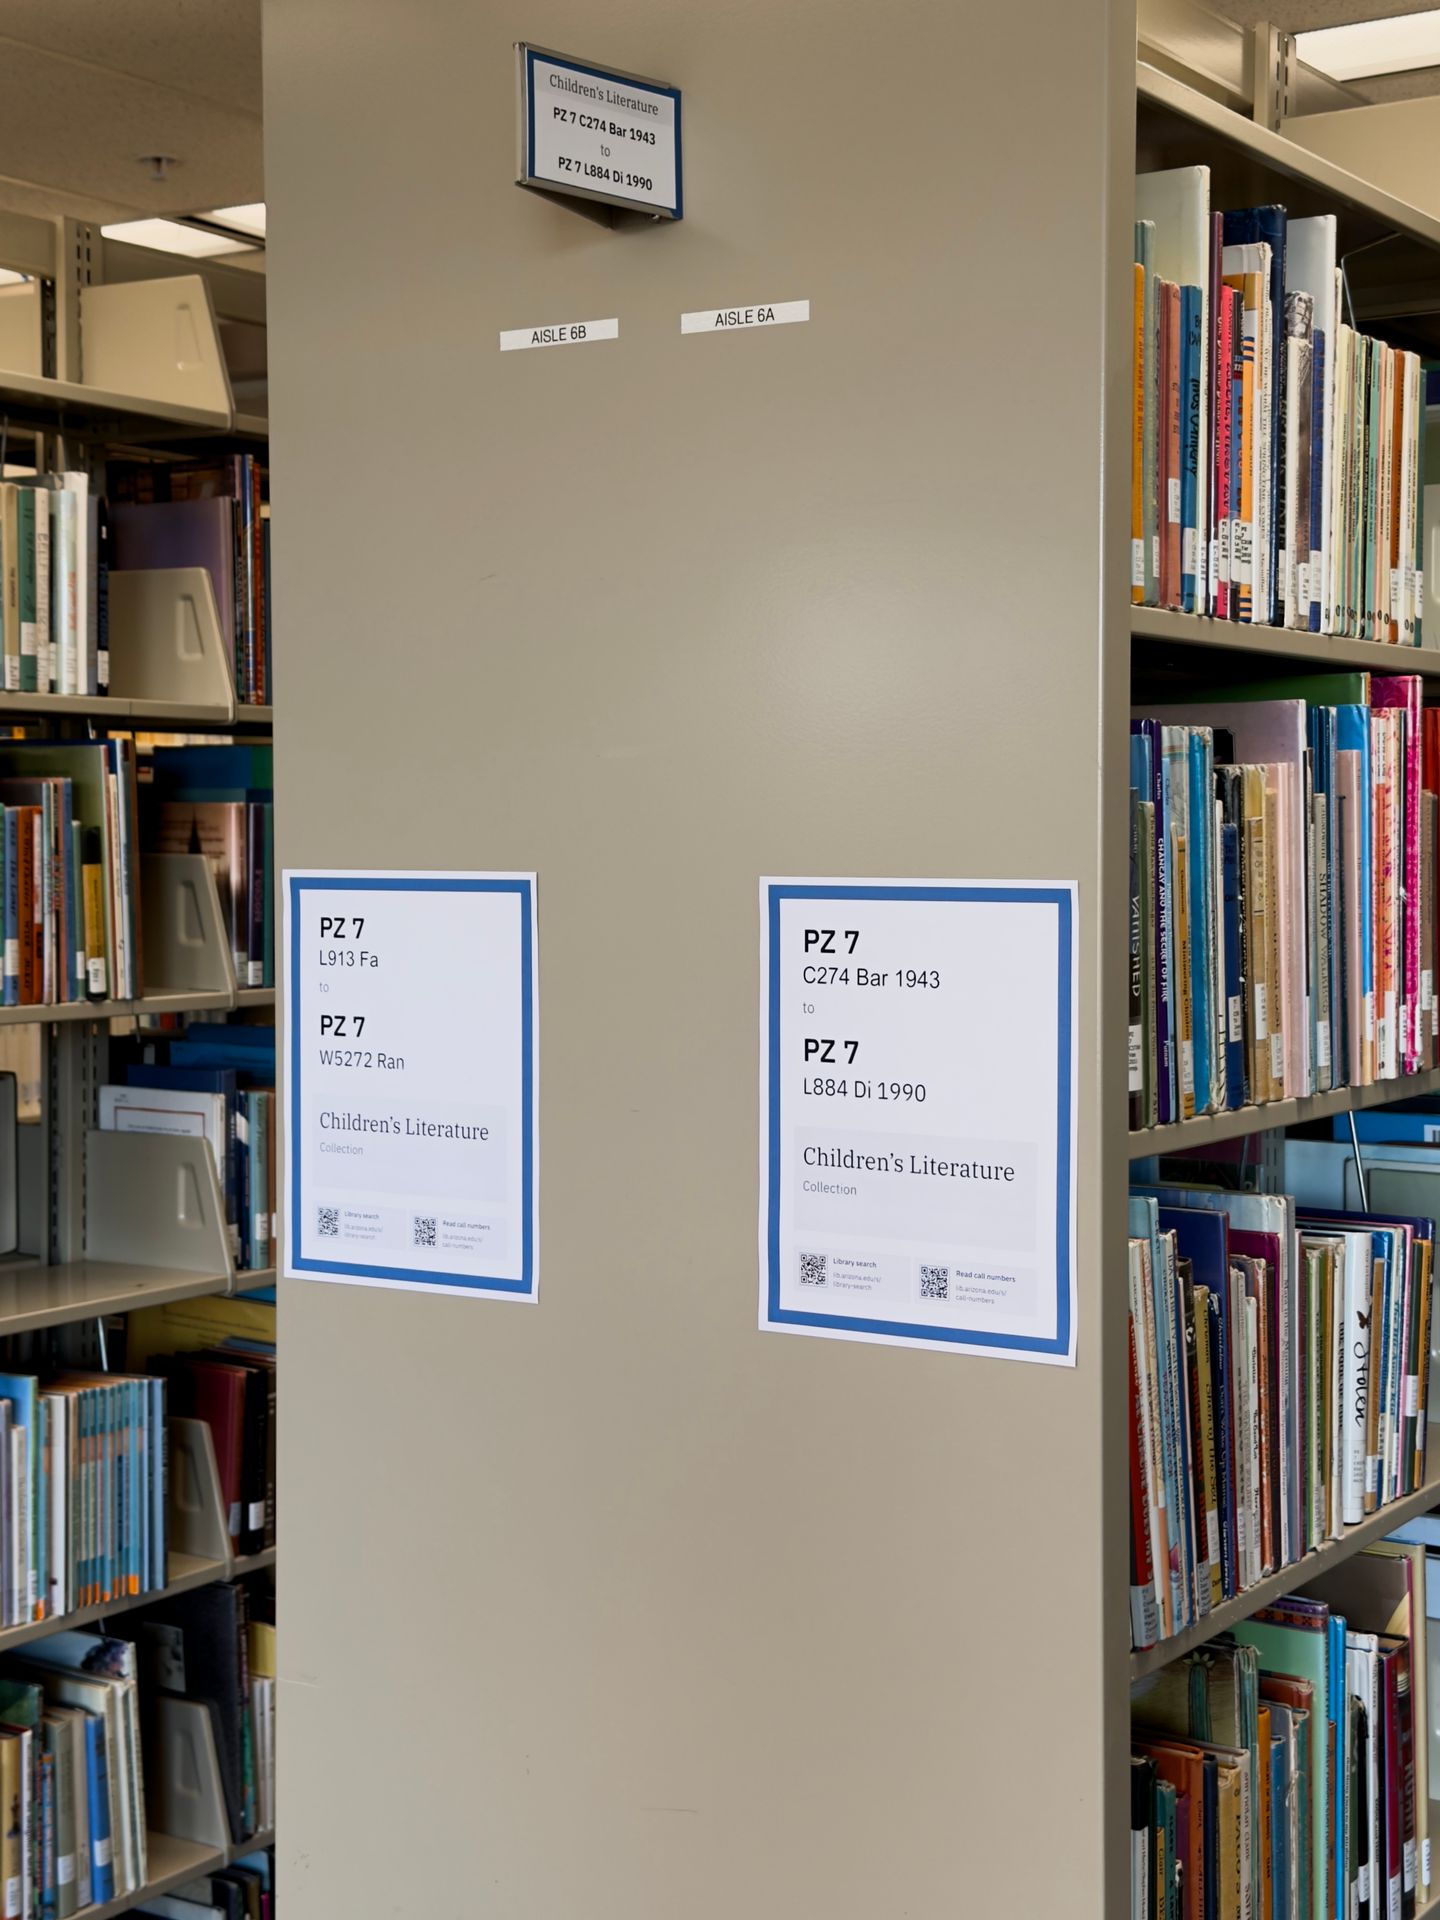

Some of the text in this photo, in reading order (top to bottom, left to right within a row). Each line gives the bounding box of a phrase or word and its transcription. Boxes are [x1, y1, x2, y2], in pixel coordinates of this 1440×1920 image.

[549, 74, 659, 116] Children's Literature
[553, 107, 656, 145] PZ 7 C274 Bar 1943
[600, 144, 611, 157] to
[557, 156, 653, 191] PZ 7 L884 Di 1990
[714, 307, 775, 327] AISLE 6A
[530, 325, 587, 344] AISLE 6B
[320, 917, 365, 939] PZ 7
[803, 929, 860, 954] PZ 7
[1131, 895, 1141, 997] VANISHED
[319, 950, 379, 968] L913 Fa
[319, 981, 329, 993] to
[802, 966, 941, 989] C274 Bar 1943
[802, 1001, 815, 1015] to
[320, 1014, 366, 1038] PZ 7
[319, 1050, 405, 1071] W5272 Ran
[803, 1038, 859, 1064] PZ 7
[803, 1078, 926, 1103] L884 Di 1990
[319, 1112, 489, 1142] Children’s Literature
[319, 1142, 364, 1156] Collection
[802, 1147, 1016, 1183] Children’s Literature
[802, 1181, 857, 1196] Collection
[442, 1219, 490, 1231] Read call numbers
[832, 1258, 877, 1269] Library search
[955, 1270, 1017, 1283] Read call numbers
[1353, 1341, 1370, 1428] Stolen
